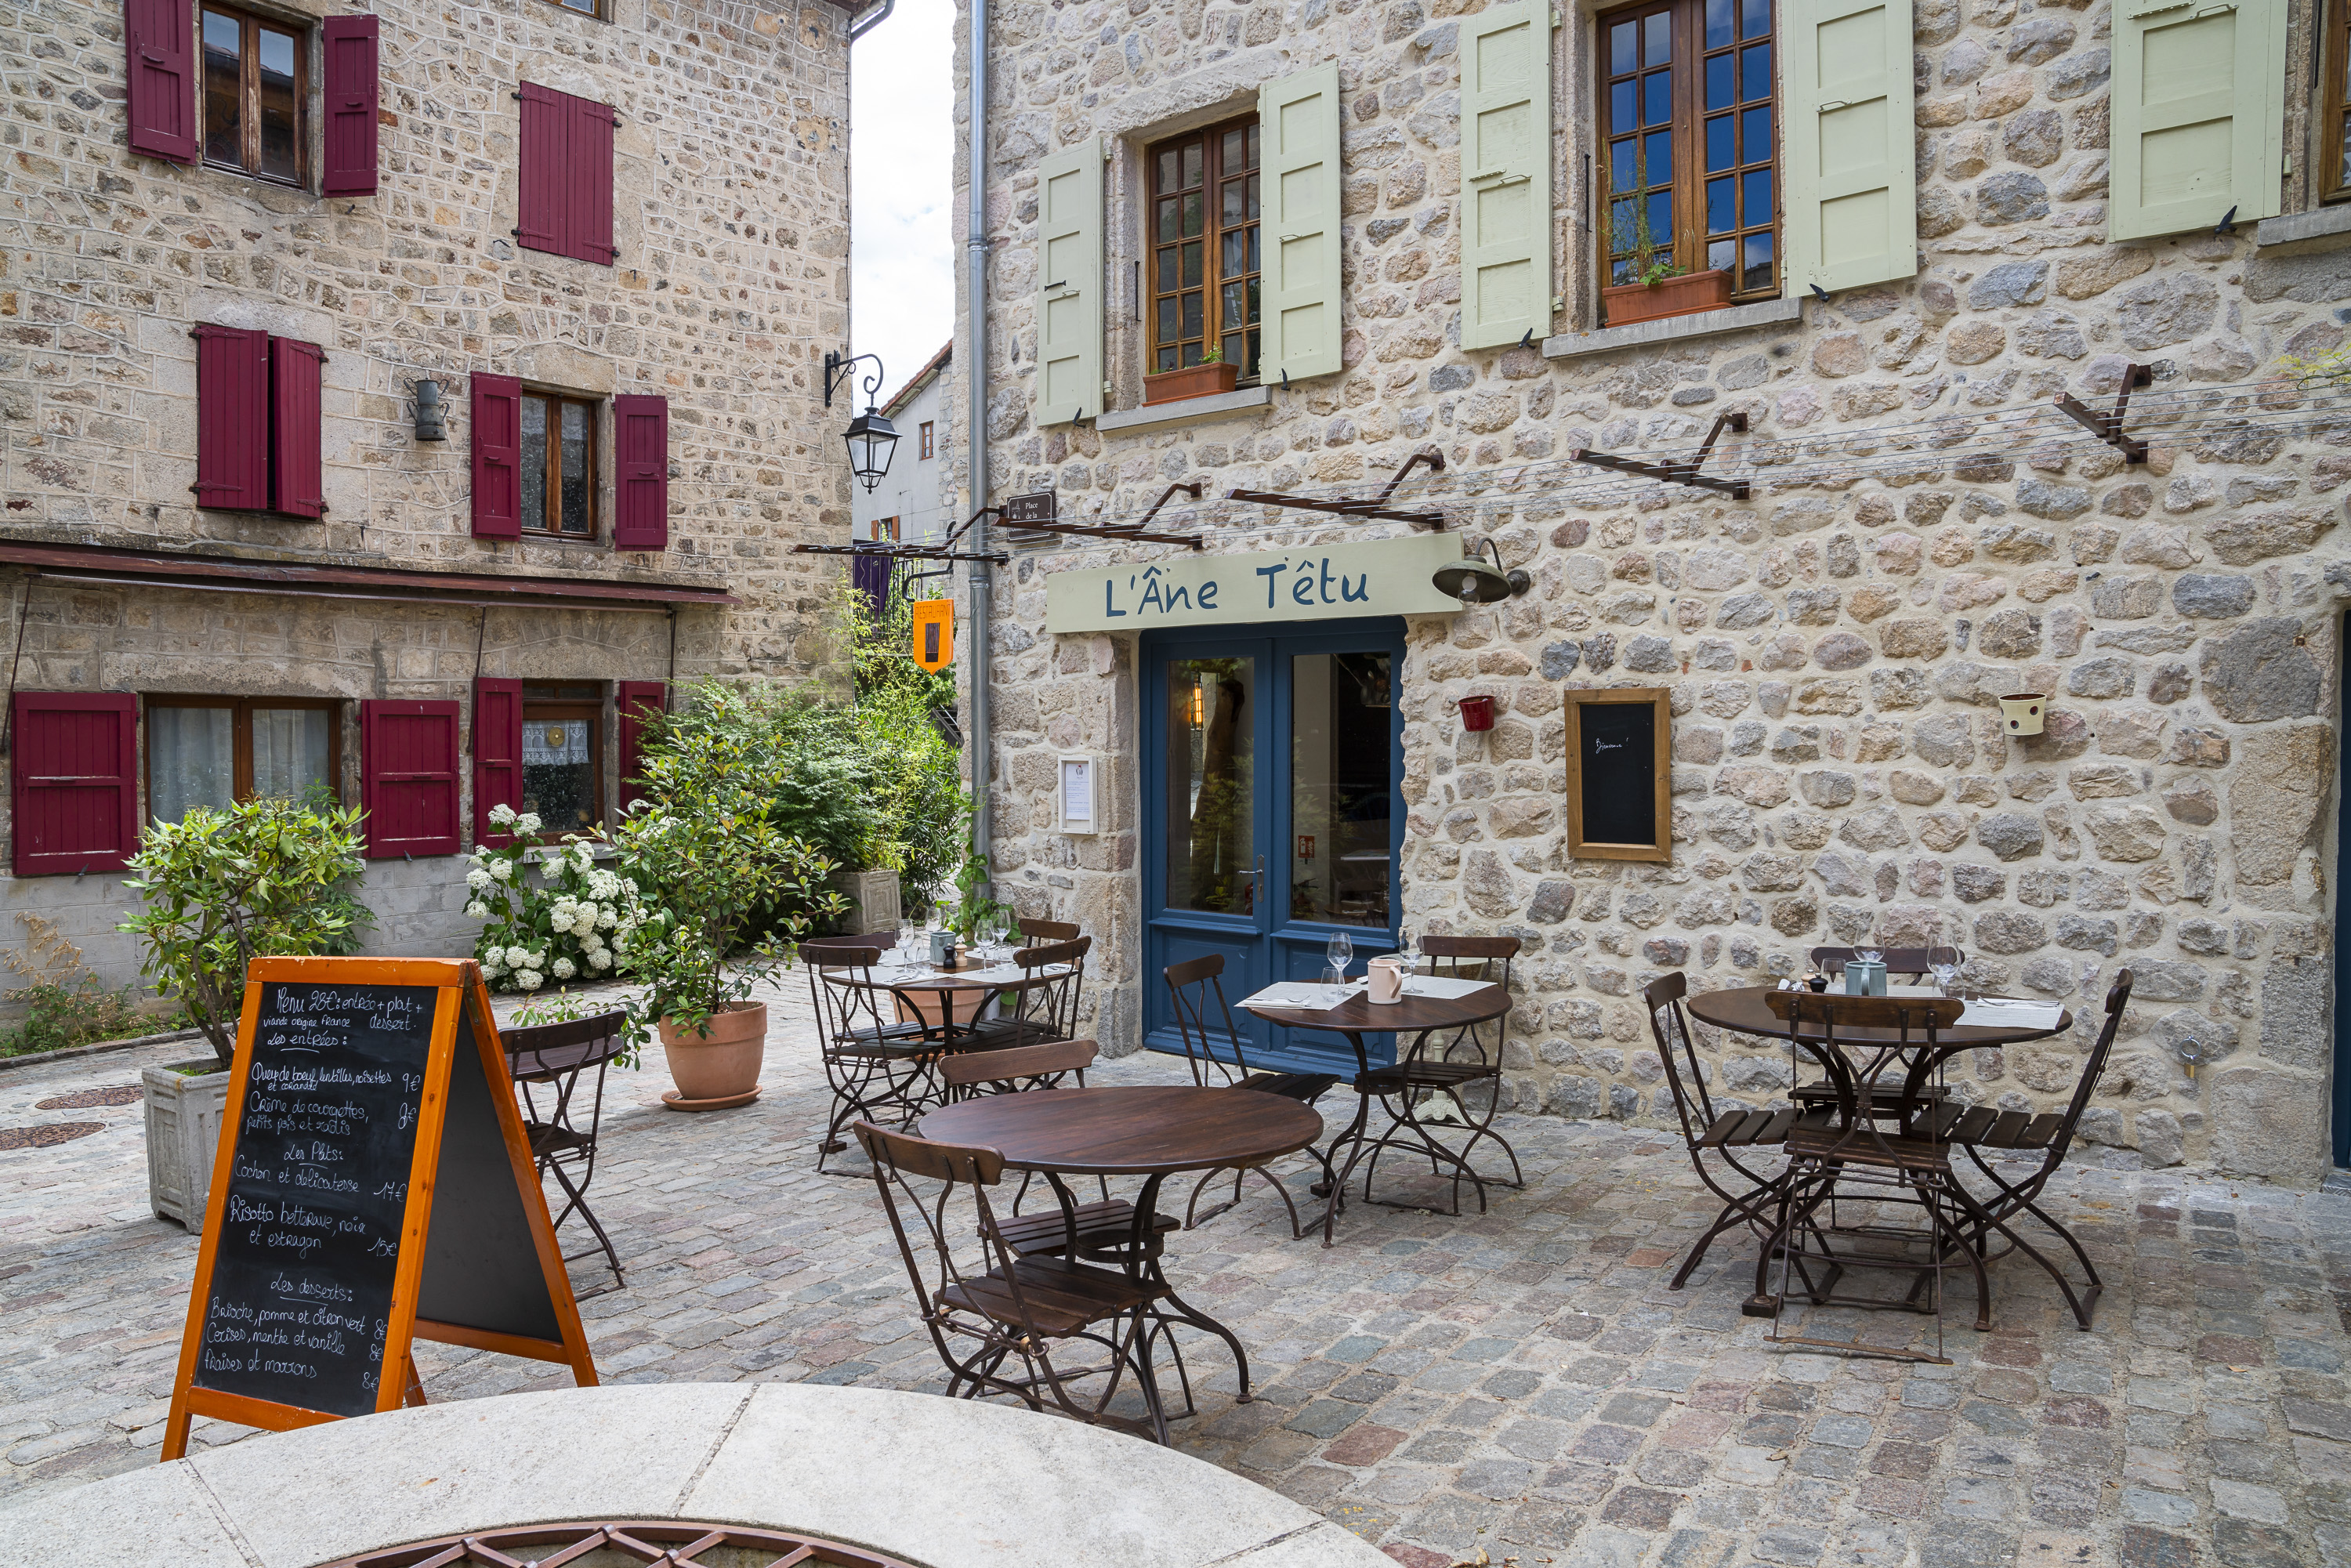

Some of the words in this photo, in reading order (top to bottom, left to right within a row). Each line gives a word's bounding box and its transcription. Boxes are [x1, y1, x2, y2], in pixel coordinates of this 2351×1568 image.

[1106, 565, 1219, 617] L'Âne
[1255, 557, 1370, 609] Têtu
[915, 603, 951, 619] RESTAURANT
[277, 987, 305, 1013] Menu
[342, 992, 376, 1011] entrée
[387, 995, 414, 1019] plat
[263, 1016, 288, 1027] viande
[292, 1017, 318, 1030] origine
[266, 1032, 286, 1045] Les
[268, 1081, 277, 1092] et
[279, 1065, 290, 1081] de
[356, 1069, 392, 1085] noisettes
[402, 1073, 421, 1093] 9€
[249, 1091, 287, 1113] Crème
[292, 1099, 306, 1114] de
[245, 1114, 273, 1135] petits
[277, 1114, 296, 1135] pois
[299, 1116, 313, 1132] et
[316, 1119, 351, 1135] radis
[284, 1144, 305, 1161] Les
[235, 1154, 272, 1182] Cochon
[278, 1167, 291, 1183] et
[373, 1181, 408, 1203] 17€
[230, 1194, 274, 1222] Risotto
[339, 1216, 367, 1235] noix
[249, 1224, 262, 1245] et
[268, 1230, 322, 1259] estragon
[367, 1237, 397, 1257] 15€
[270, 1271, 294, 1293] Les
[259, 1309, 295, 1327] pomme
[298, 1309, 311, 1324] et
[313, 1307, 343, 1327] citron
[345, 1315, 366, 1335] vert
[252, 1327, 290, 1345] menthe
[293, 1329, 306, 1346] et
[308, 1330, 346, 1356] vanille
[248, 1348, 261, 1371] et
[265, 1359, 317, 1379] marrons
[362, 1371, 380, 1393] 8€
